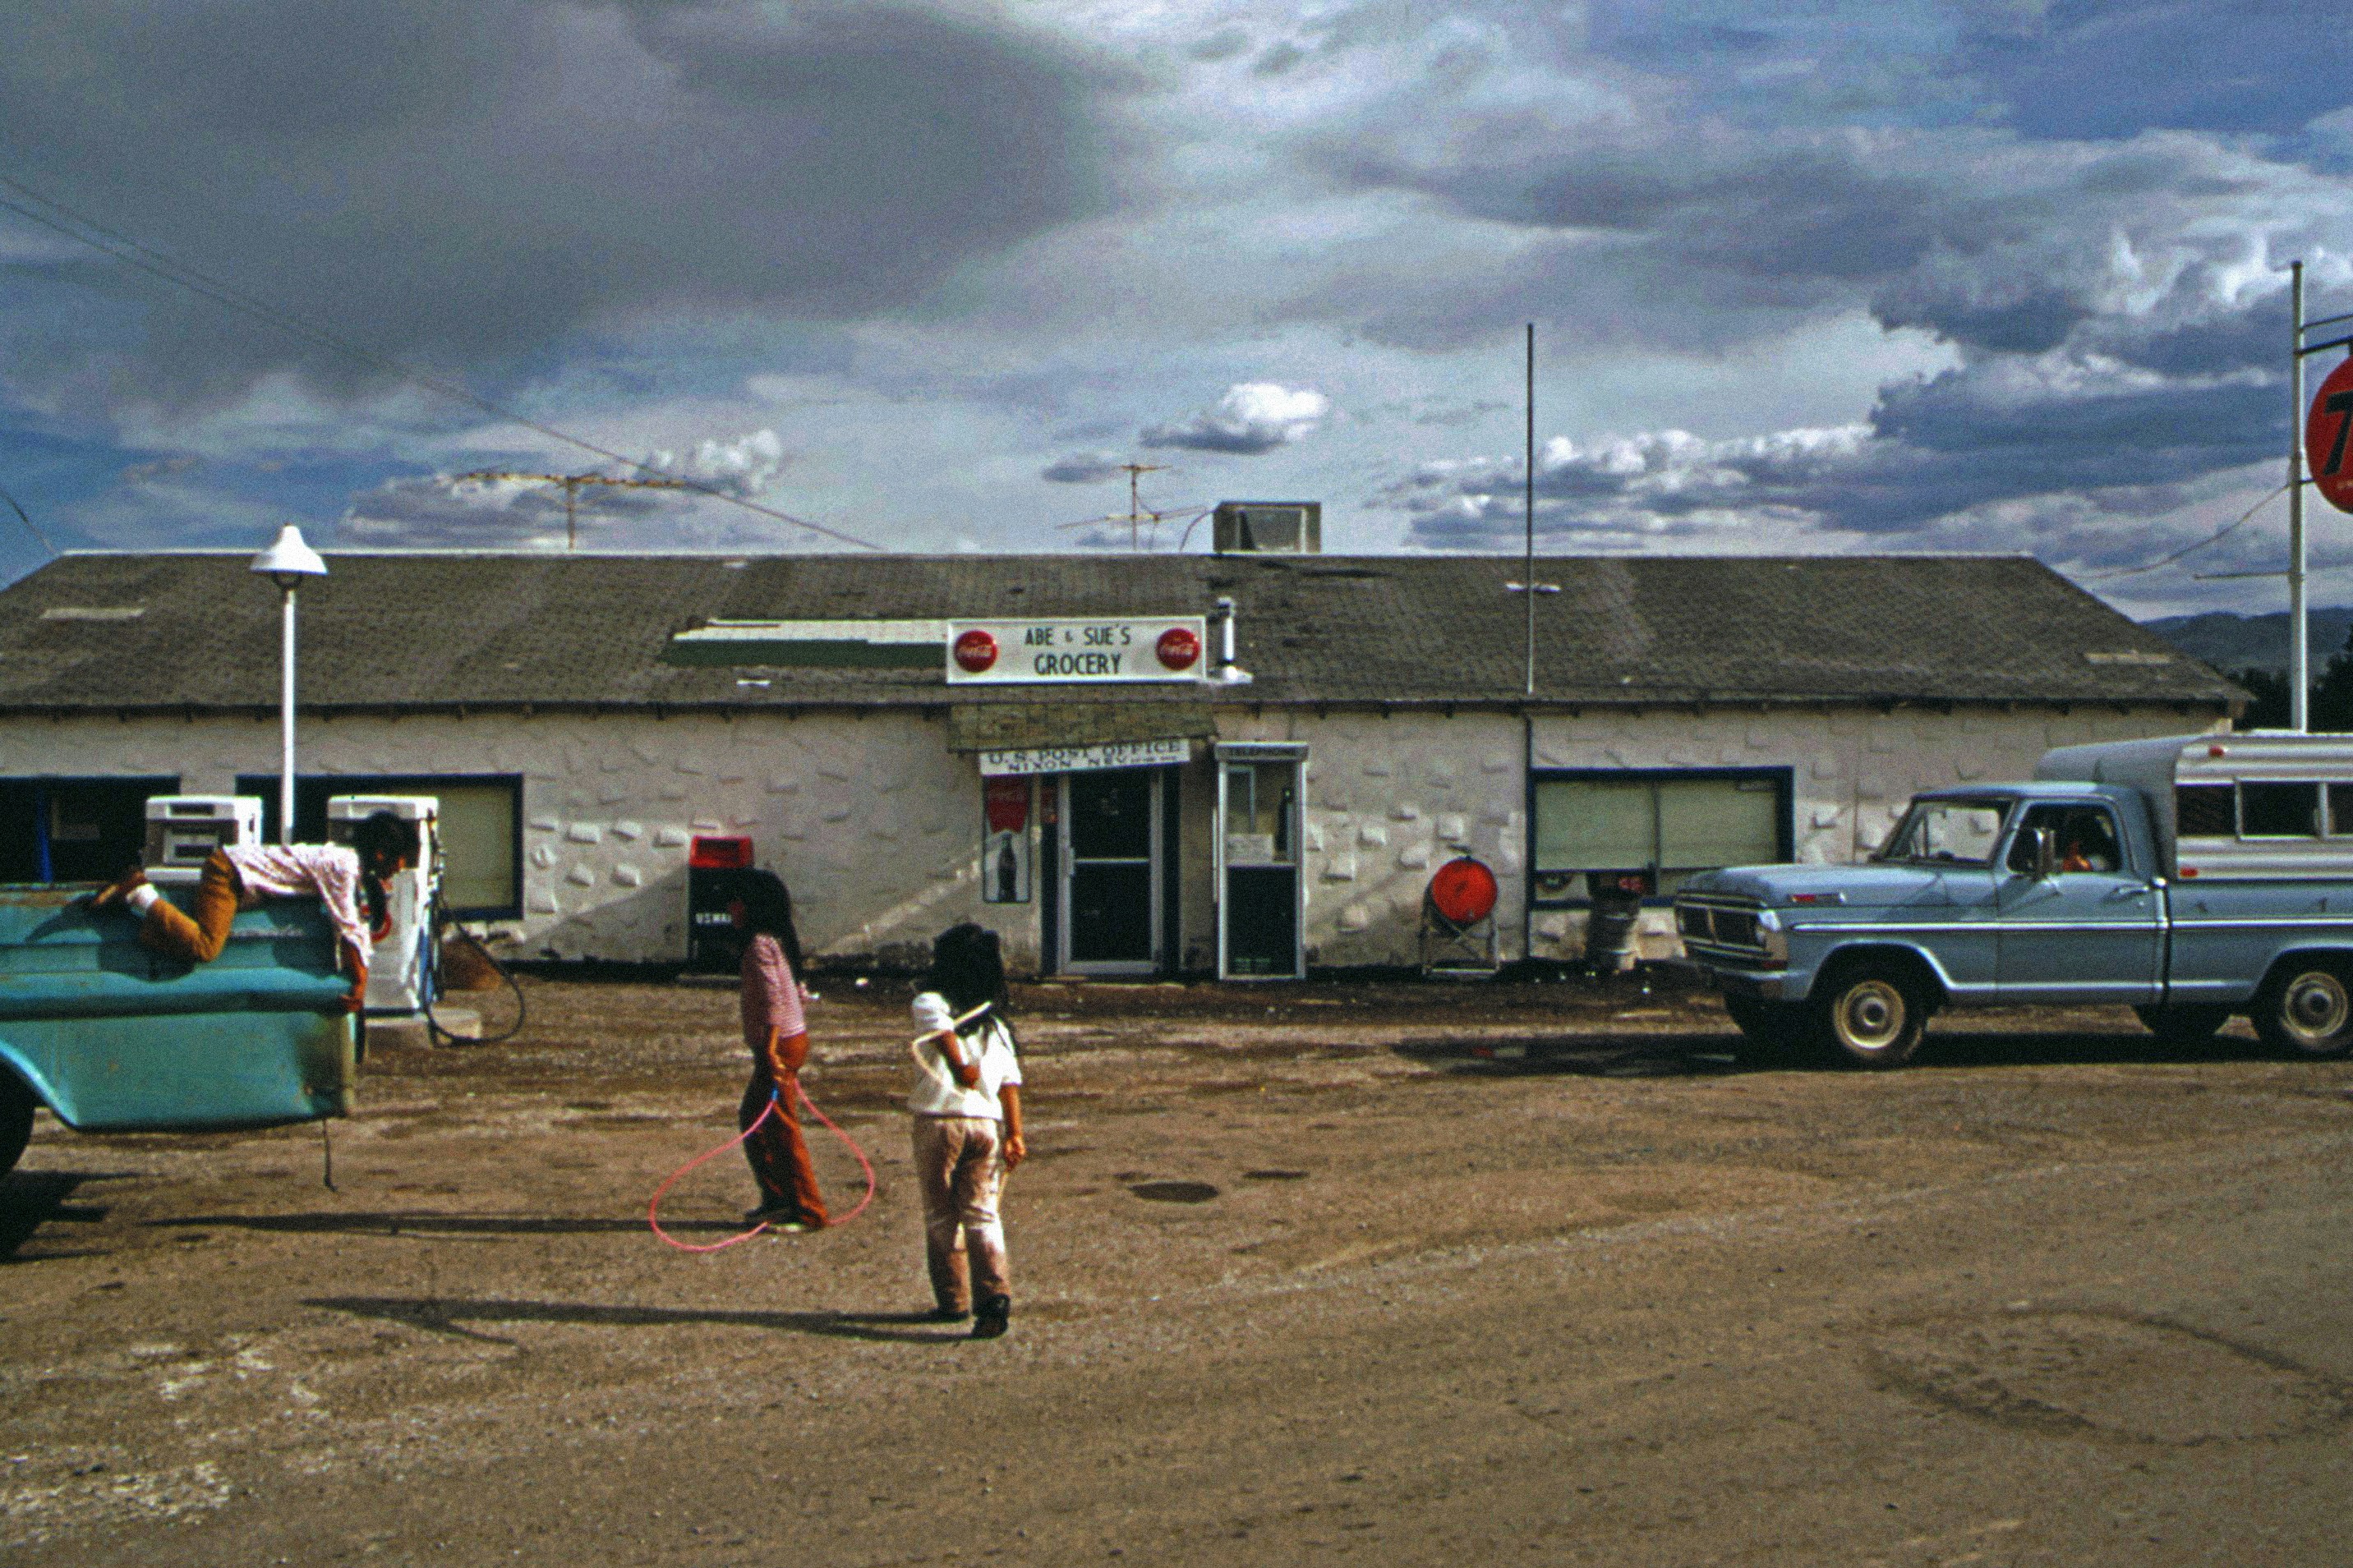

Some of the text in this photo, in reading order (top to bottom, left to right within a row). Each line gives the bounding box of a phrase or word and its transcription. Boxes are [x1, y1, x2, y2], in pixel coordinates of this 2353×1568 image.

[1025, 623, 1131, 646] ABE & SUE'S
[1034, 653, 1122, 674] GROCERY
[1039, 746, 1091, 761] POST
[1103, 740, 1181, 754] OFFICE
[1008, 760, 1071, 772] NIXON
